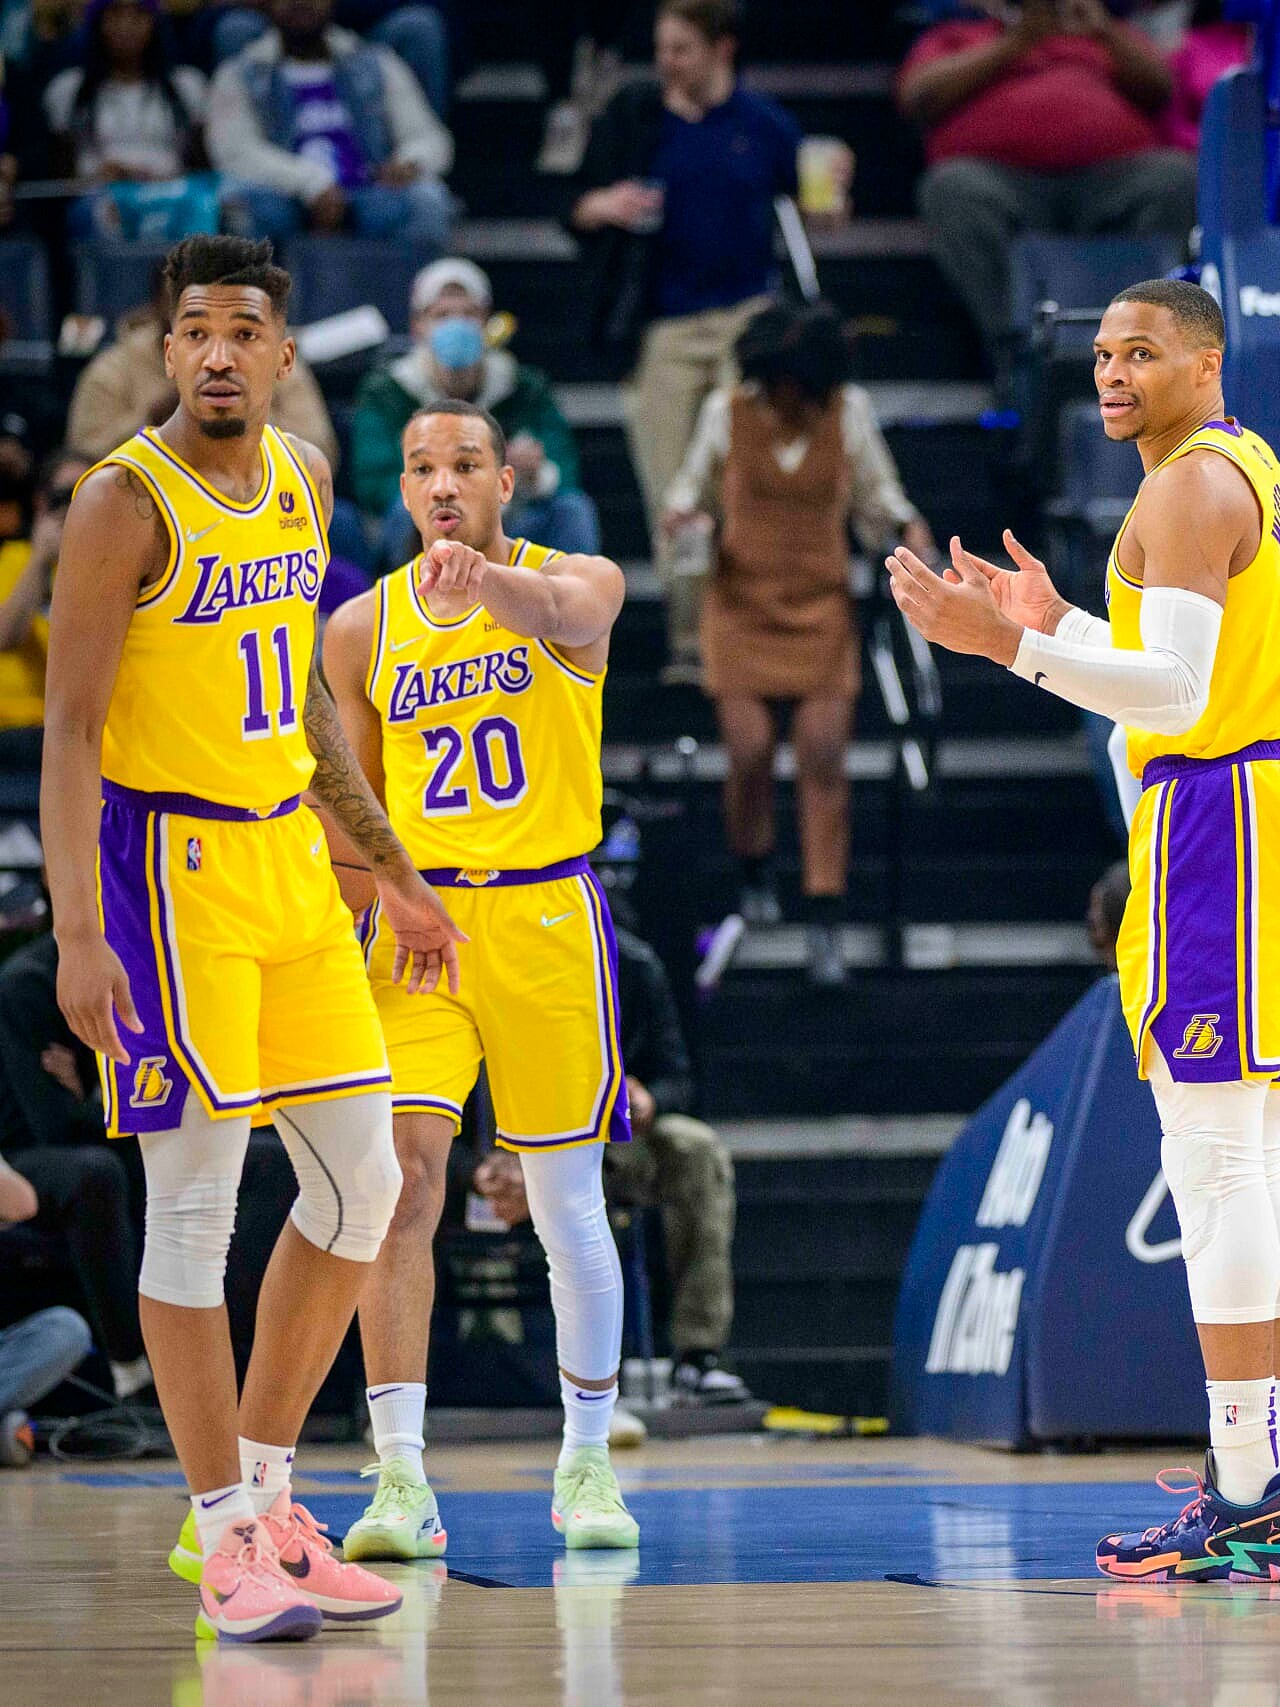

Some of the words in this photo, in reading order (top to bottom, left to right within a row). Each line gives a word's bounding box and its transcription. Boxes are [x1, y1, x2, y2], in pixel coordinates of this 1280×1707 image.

[172, 547, 322, 624] LAKERS
[238, 623, 298, 741] 11
[387, 646, 534, 723] LAKERS
[419, 714, 530, 819] 20
